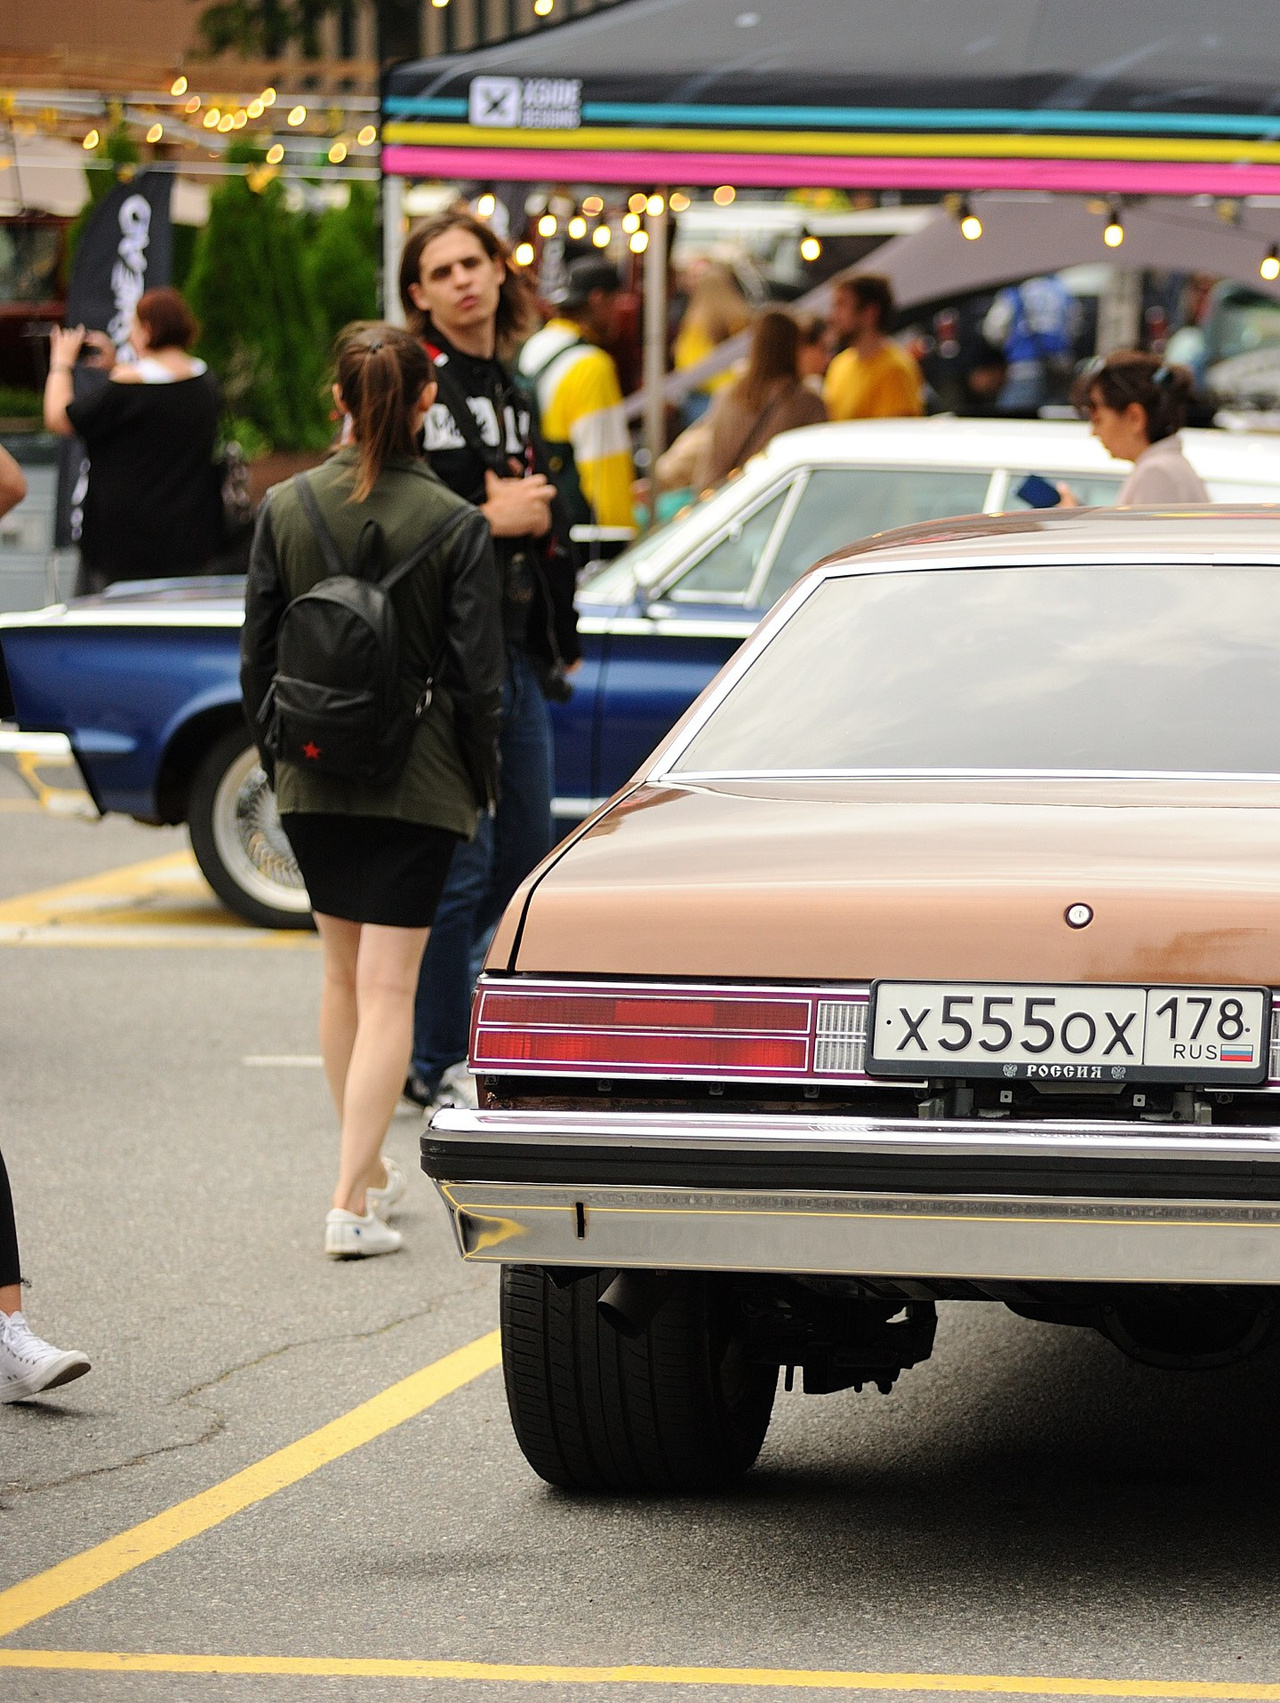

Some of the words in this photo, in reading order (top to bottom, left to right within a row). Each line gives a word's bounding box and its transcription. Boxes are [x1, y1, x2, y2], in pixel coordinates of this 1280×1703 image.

[896, 995, 1137, 1056] X555OX
[1155, 996, 1243, 1041] 178
[1173, 1043, 1218, 1060] RUS
[1025, 1062, 1103, 1079] РОССИЯ
